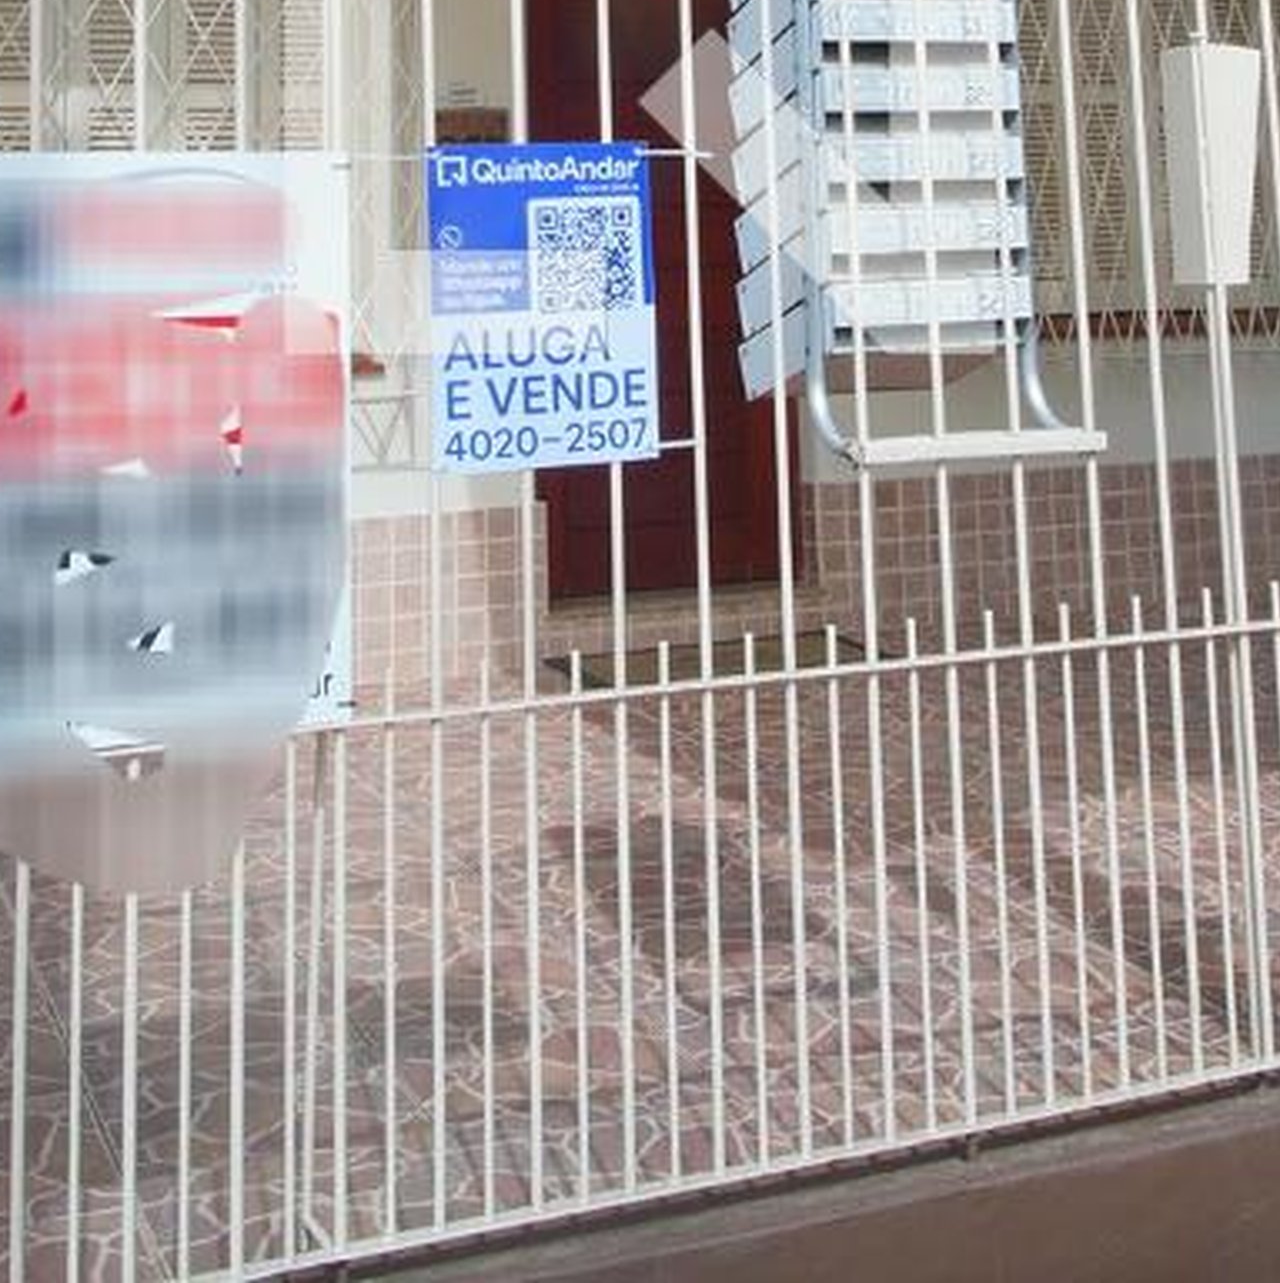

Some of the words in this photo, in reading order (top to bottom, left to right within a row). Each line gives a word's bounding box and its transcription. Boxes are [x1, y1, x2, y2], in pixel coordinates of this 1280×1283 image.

[472, 156, 639, 183] QuintoAndar
[444, 325, 611, 371] ALUGA
[447, 380, 472, 420] E
[486, 368, 647, 415] VENDE
[445, 417, 647, 461] 4020-2507
